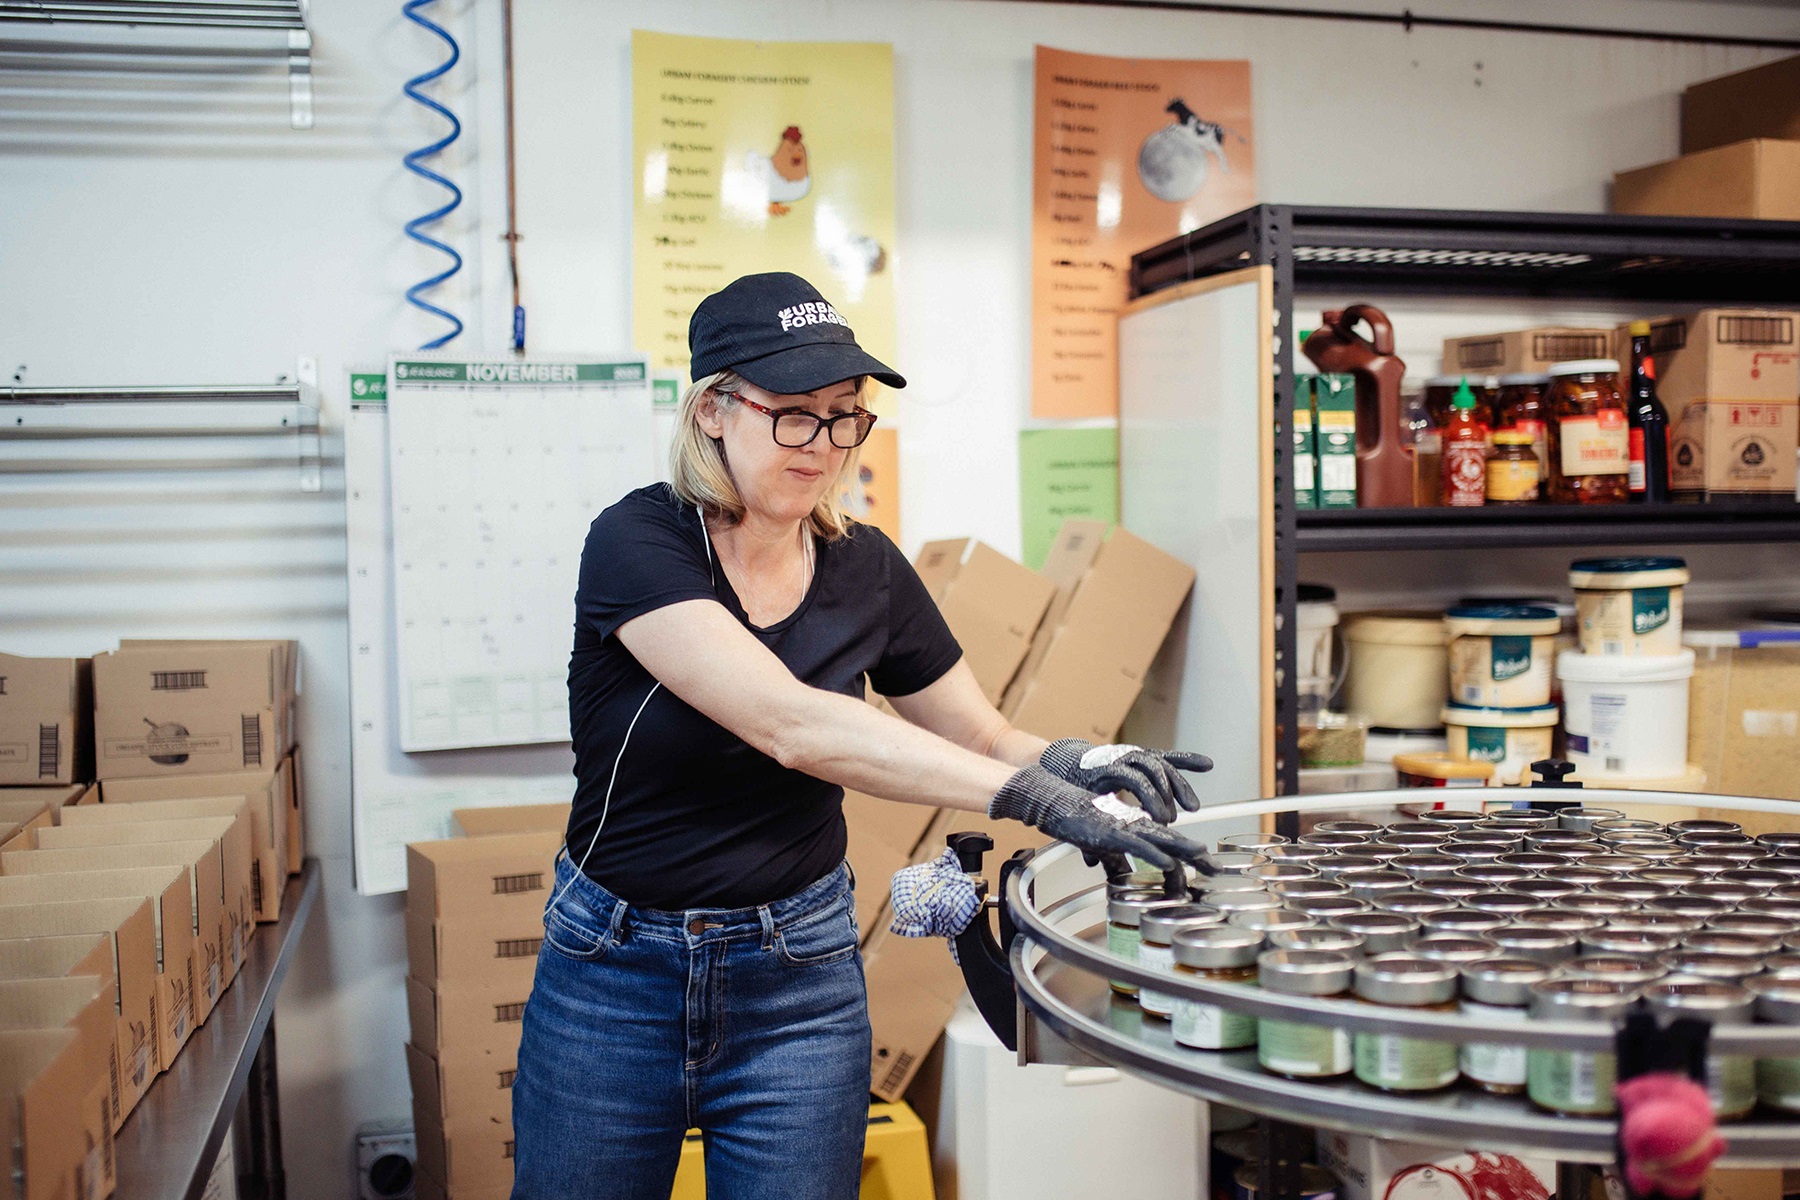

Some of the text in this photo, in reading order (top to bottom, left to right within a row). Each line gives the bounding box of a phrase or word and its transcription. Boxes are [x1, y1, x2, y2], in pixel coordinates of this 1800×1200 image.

[792, 302, 837, 316] URBA
[781, 313, 848, 332] FORAGE
[465, 364, 578, 381] NOVEMBER
